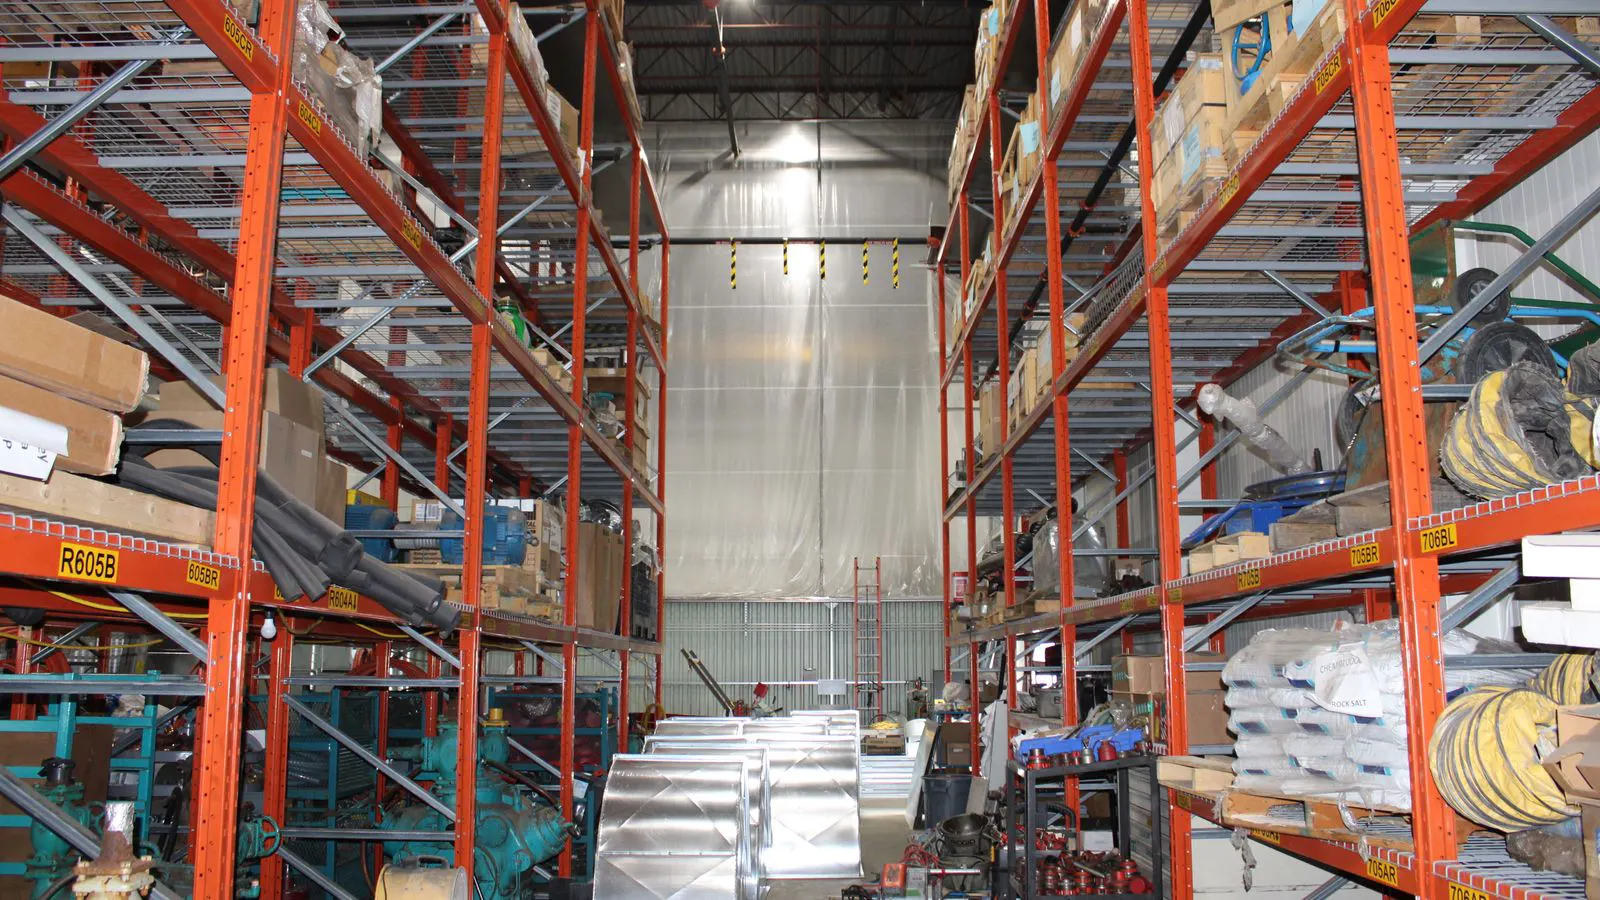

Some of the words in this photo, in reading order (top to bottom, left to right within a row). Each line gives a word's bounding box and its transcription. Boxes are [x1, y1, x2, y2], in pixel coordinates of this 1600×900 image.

[225, 17, 253, 58] 605CR
[1316, 55, 1340, 92] 705CR
[1422, 529, 1456, 551] 706BL
[61, 546, 116, 579] R605B
[1352, 546, 1379, 566] 705BR
[188, 563, 219, 587] 605BR
[1238, 568, 1260, 589] R705B
[1331, 700, 1350, 708] ROCK
[1352, 700, 1367, 708] SALT
[1368, 858, 1397, 884] 705AR
